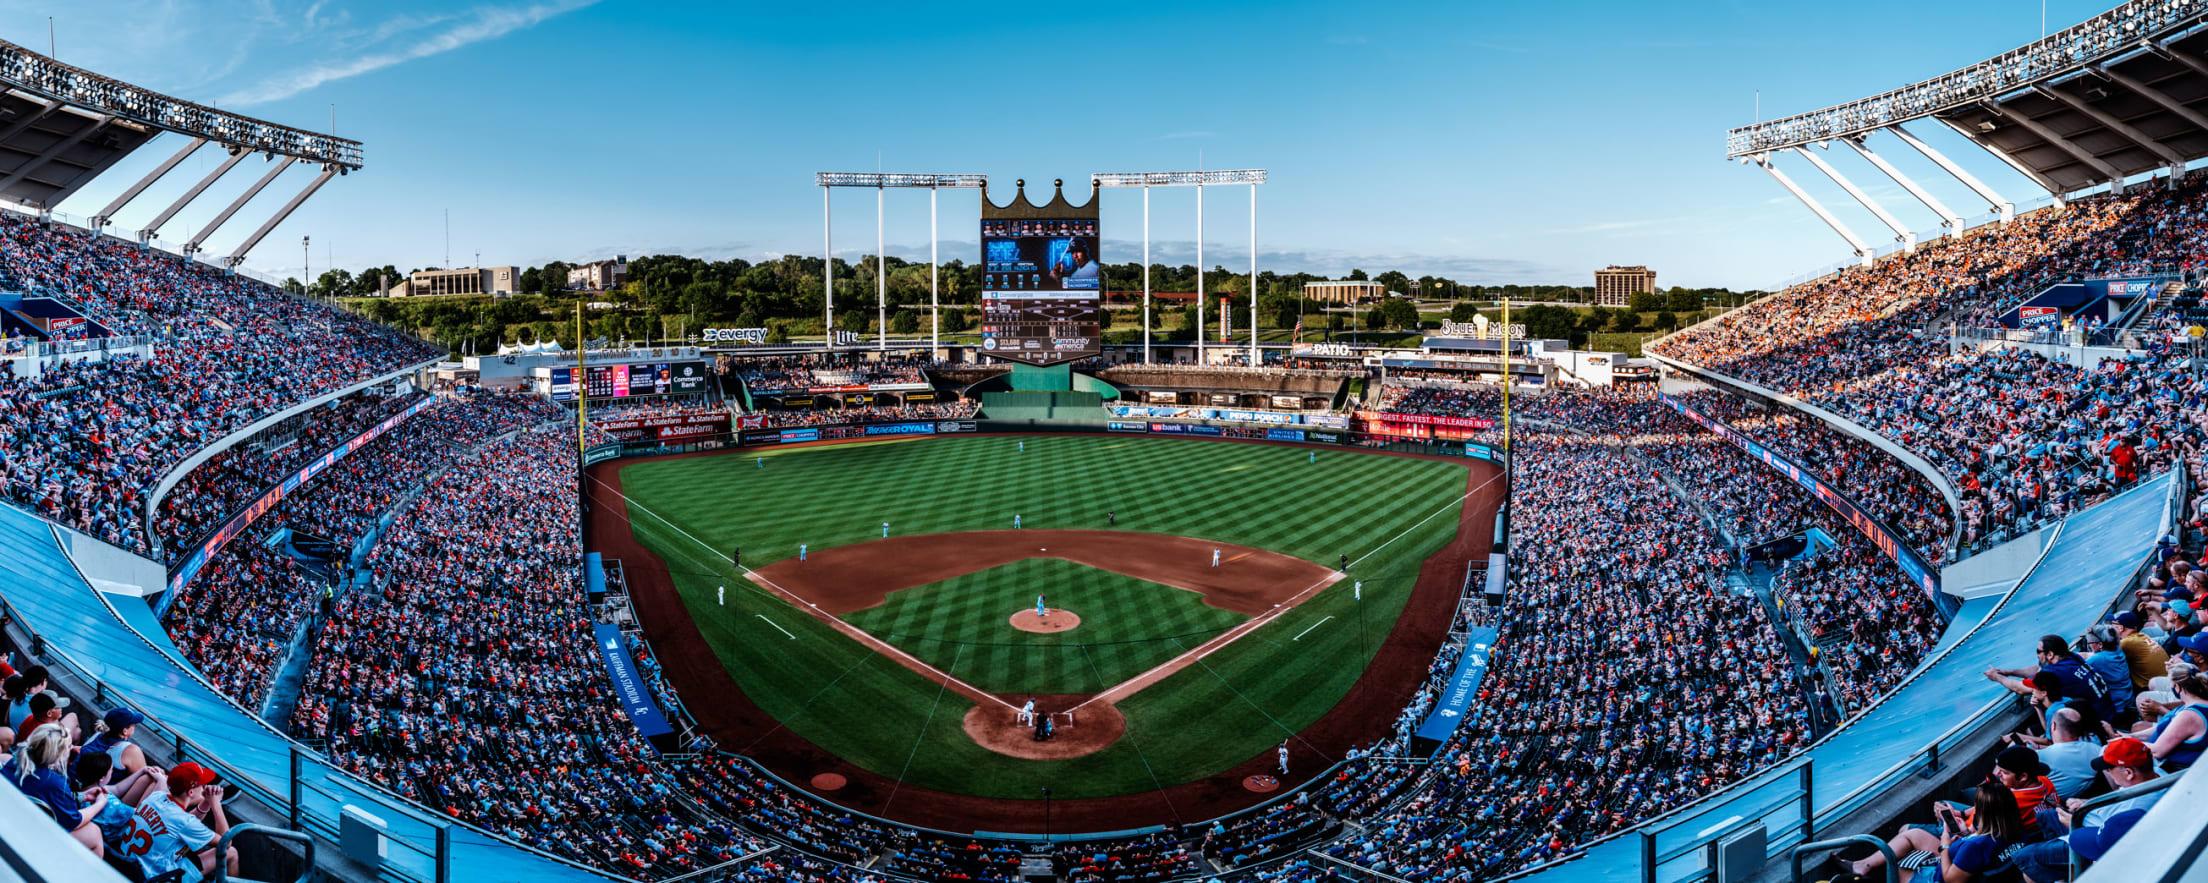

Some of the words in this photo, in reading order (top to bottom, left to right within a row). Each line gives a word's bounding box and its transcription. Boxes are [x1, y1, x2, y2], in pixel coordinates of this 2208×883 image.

[2110, 283, 2125, 293] PRICE
[2022, 308, 2044, 317] PRICE
[53, 319, 73, 329] PRICE
[2021, 314, 2056, 326] CHOPPER
[1440, 318, 1474, 336] BLUE
[718, 328, 767, 343] evergy
[836, 330, 859, 345] Lite
[1050, 337, 1090, 345] Community
[652, 349, 663, 358] 20
[671, 348, 680, 356] 10
[689, 347, 695, 355] 5
[1314, 343, 1349, 356] PATIO
[504, 355, 516, 365] 42
[1229, 412, 1253, 420] PEPSI
[1254, 413, 1283, 422] PORCH
[1402, 415, 1432, 423] FASTEST.
[1433, 417, 1446, 425] THE
[1447, 419, 1474, 427] LEADER
[893, 425, 928, 433] ROYAL
[1369, 422, 1390, 433] Mobile
[608, 652, 629, 679] KAUFFMAN
[620, 678, 641, 704] STADIUM
[1463, 668, 1477, 679] THE
[1459, 680, 1471, 688] OF
[1449, 687, 1468, 706] HOME
[119, 818, 153, 856] 22
